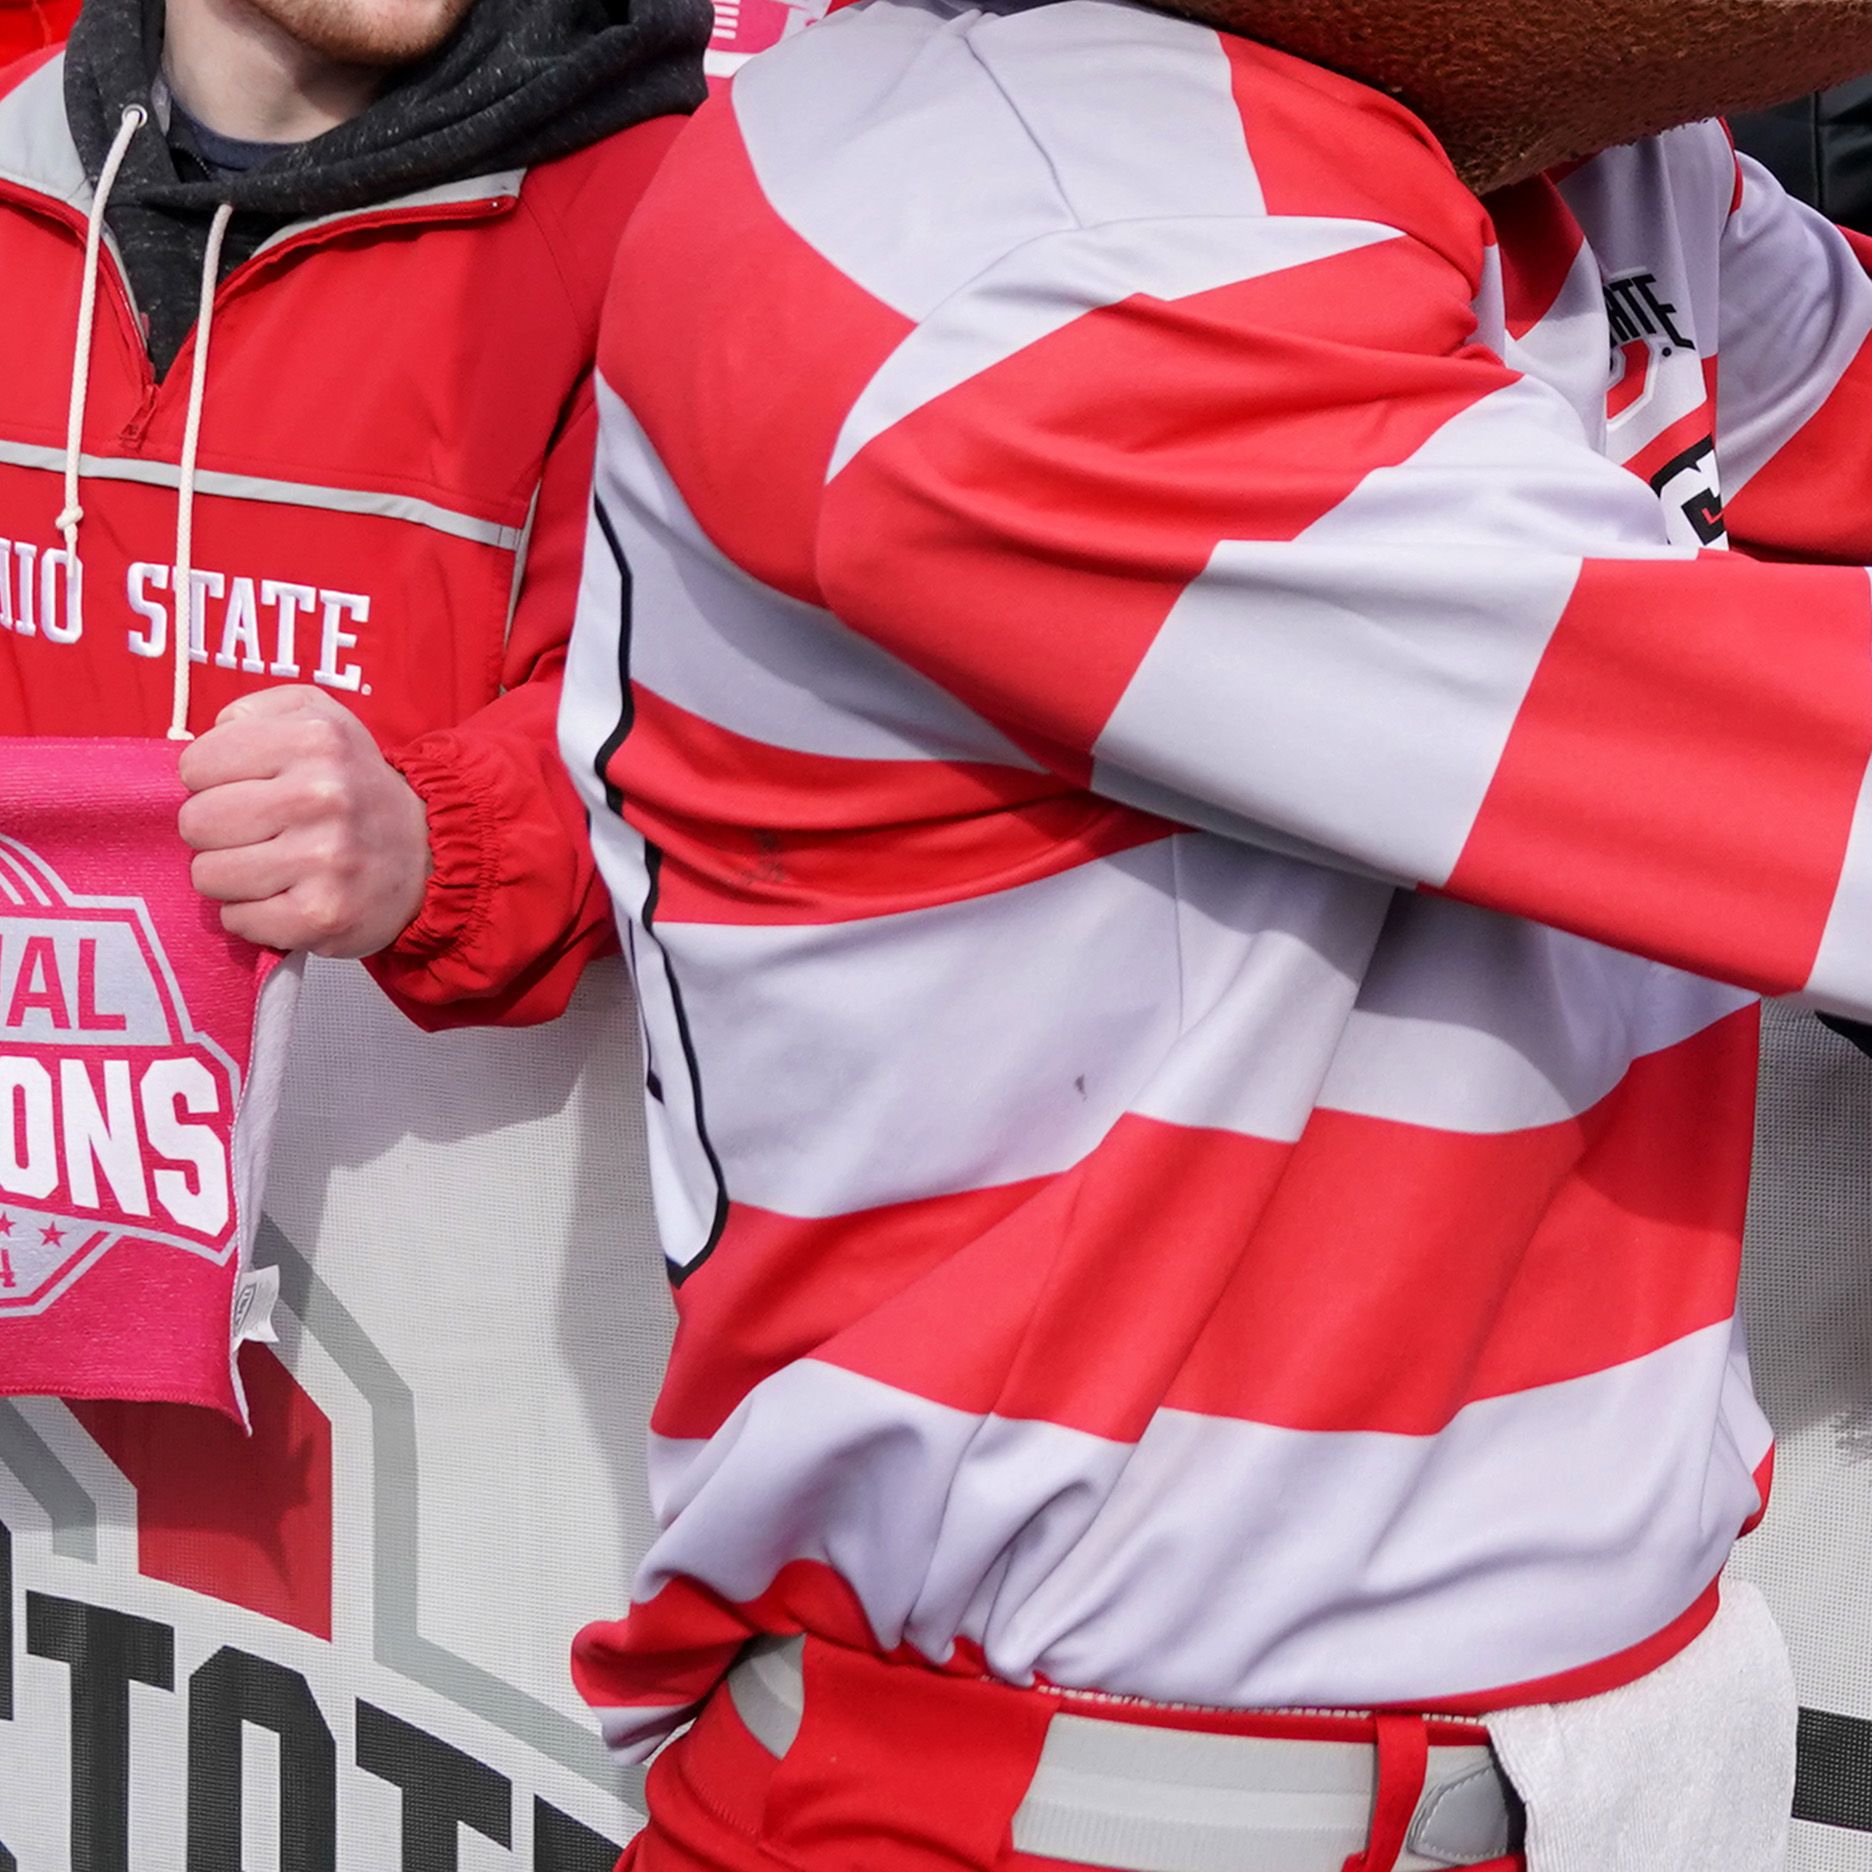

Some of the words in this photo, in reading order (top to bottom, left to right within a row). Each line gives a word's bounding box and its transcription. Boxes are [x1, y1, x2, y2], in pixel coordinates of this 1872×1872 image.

[1603, 273, 1696, 350] ATE
[0, 536, 83, 644] IO
[127, 561, 370, 691] STATE
